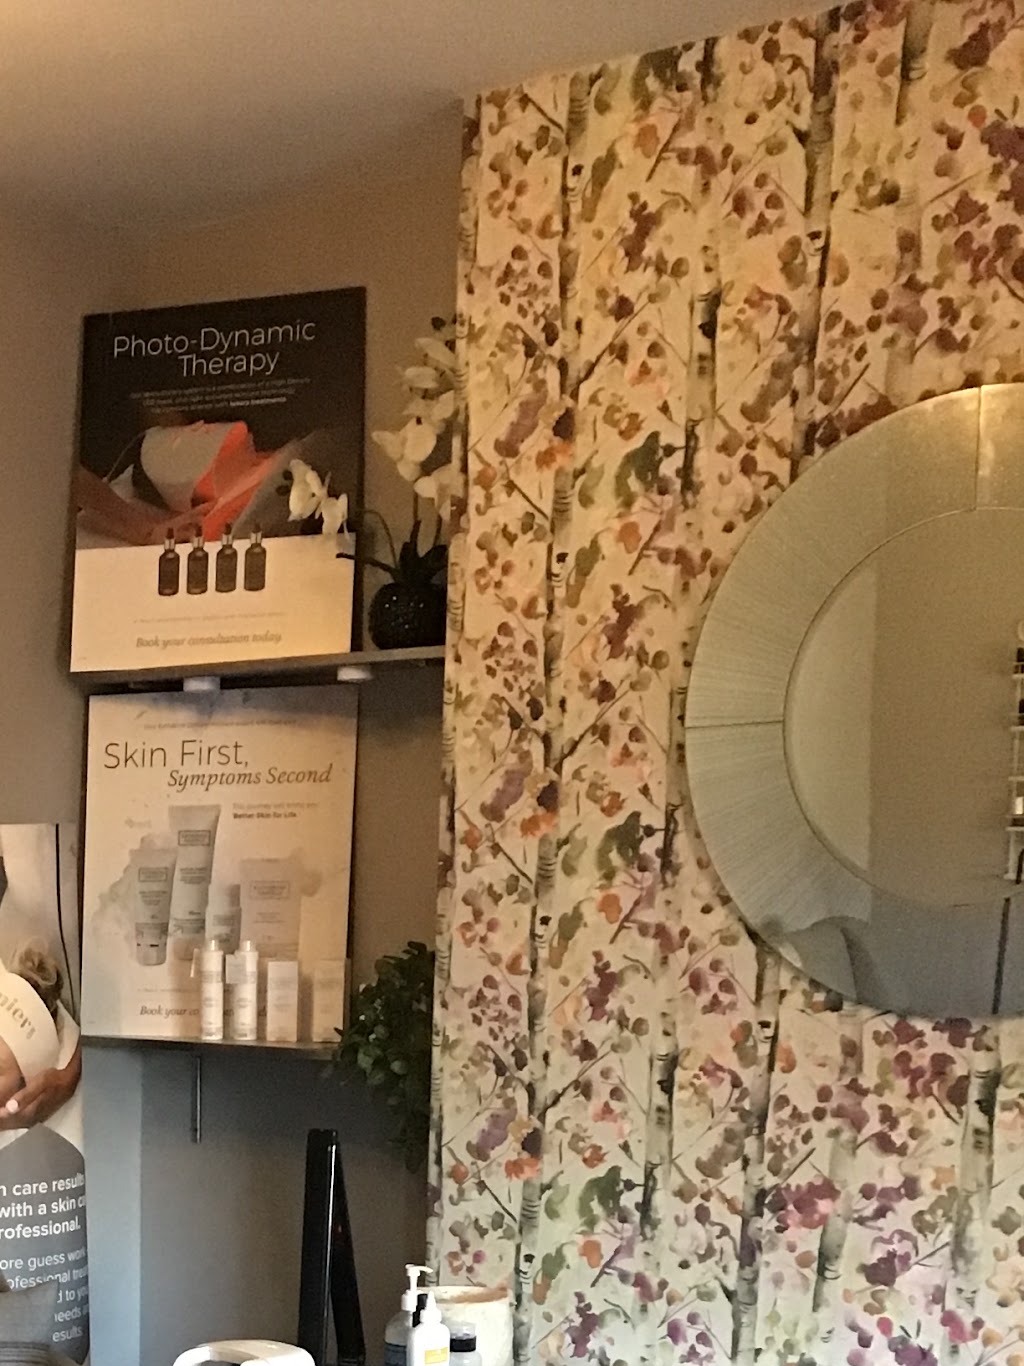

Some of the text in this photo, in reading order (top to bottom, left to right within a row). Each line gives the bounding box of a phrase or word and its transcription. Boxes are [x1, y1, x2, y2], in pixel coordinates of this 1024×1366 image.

[113, 319, 316, 358] Photo-Dynamic
[178, 352, 280, 377] Therapy
[136, 635, 160, 648] Book
[103, 738, 249, 769] Skin First,
[168, 763, 333, 793] Symptoms Second
[139, 1004, 162, 1016] Book
[163, 1007, 188, 1019] your
[12, 1182, 48, 1196] care
[38, 1203, 47, 1216] a
[51, 1195, 76, 1214] skin
[27, 1252, 65, 1272] guess
